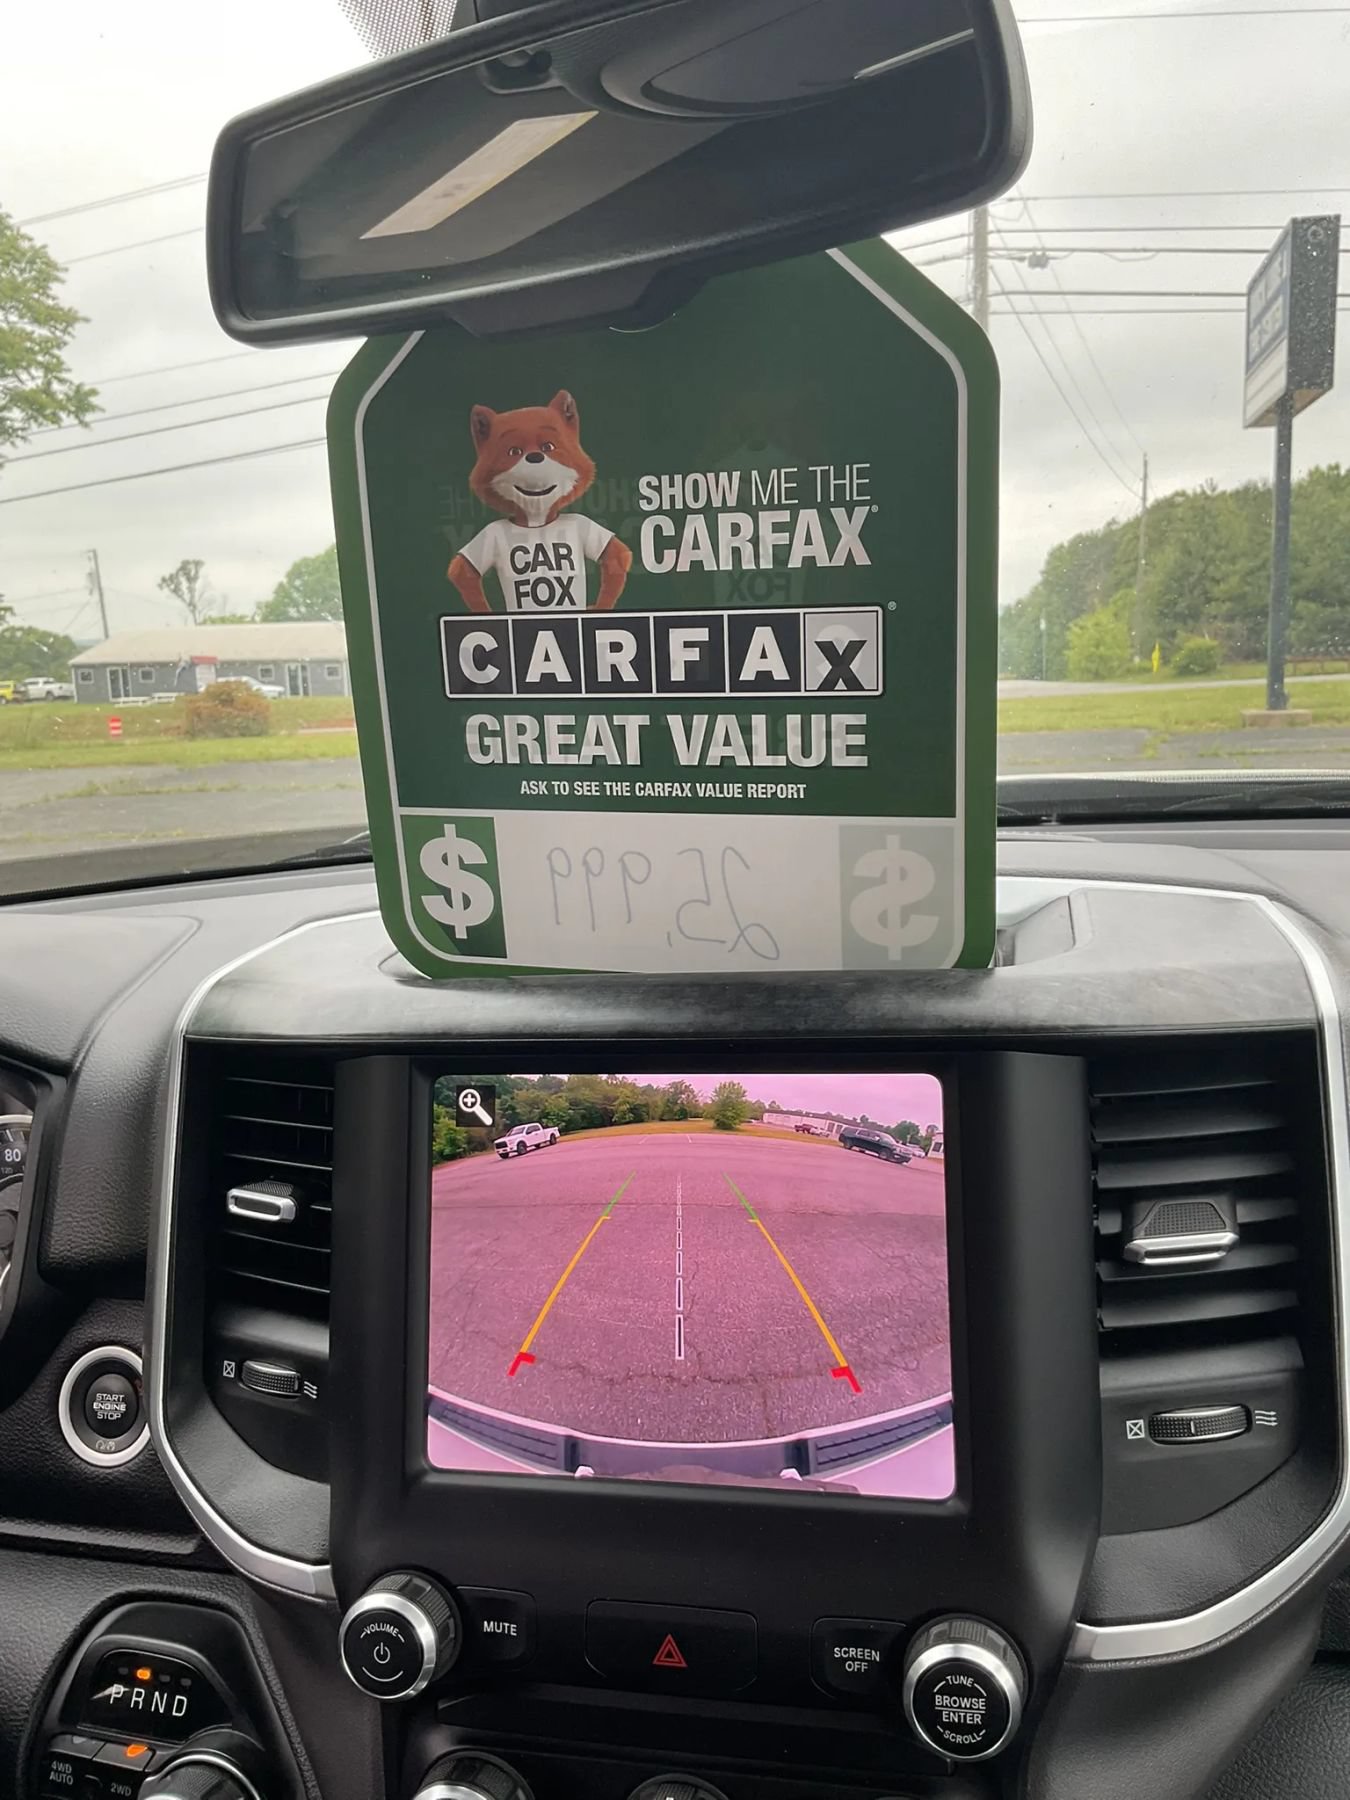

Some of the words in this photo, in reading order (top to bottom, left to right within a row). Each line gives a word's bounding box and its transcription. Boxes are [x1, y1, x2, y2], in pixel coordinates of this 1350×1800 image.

[639, 471, 740, 511] SHOW
[751, 467, 798, 505] ME
[808, 463, 871, 502] THE
[640, 505, 872, 574] CARFAX
[510, 542, 575, 575] CAR
[514, 576, 576, 608] FOX
[458, 626, 867, 691] CARFAX
[465, 713, 650, 766] GREAT
[667, 714, 869, 767] VALUE
[520, 781, 548, 795] ASK
[552, 781, 569, 796] TO
[574, 782, 600, 796] SEE
[603, 782, 630, 797] THE
[635, 782, 692, 797] CARFAX
[696, 783, 743, 798] VALUE
[747, 783, 807, 799] REPORT
[4, 1148, 21, 1162] 80
[96, 1393, 125, 1402] START
[93, 1402, 126, 1411] ENGINE
[97, 1411, 121, 1420] STOP
[364, 1622, 399, 1637] VOLUME
[483, 1620, 517, 1636] MUTE
[833, 1647, 880, 1662] SCREEN
[845, 1660, 869, 1673] OFF
[946, 1675, 975, 1687] TUNE
[935, 1694, 986, 1710] BROWSE
[942, 1711, 982, 1725] ENTER
[943, 1730, 982, 1744] SCROLL
[51, 1760, 72, 1774] 4WD
[49, 1771, 73, 1785] AUTO
[110, 1782, 132, 1797] 2WD
